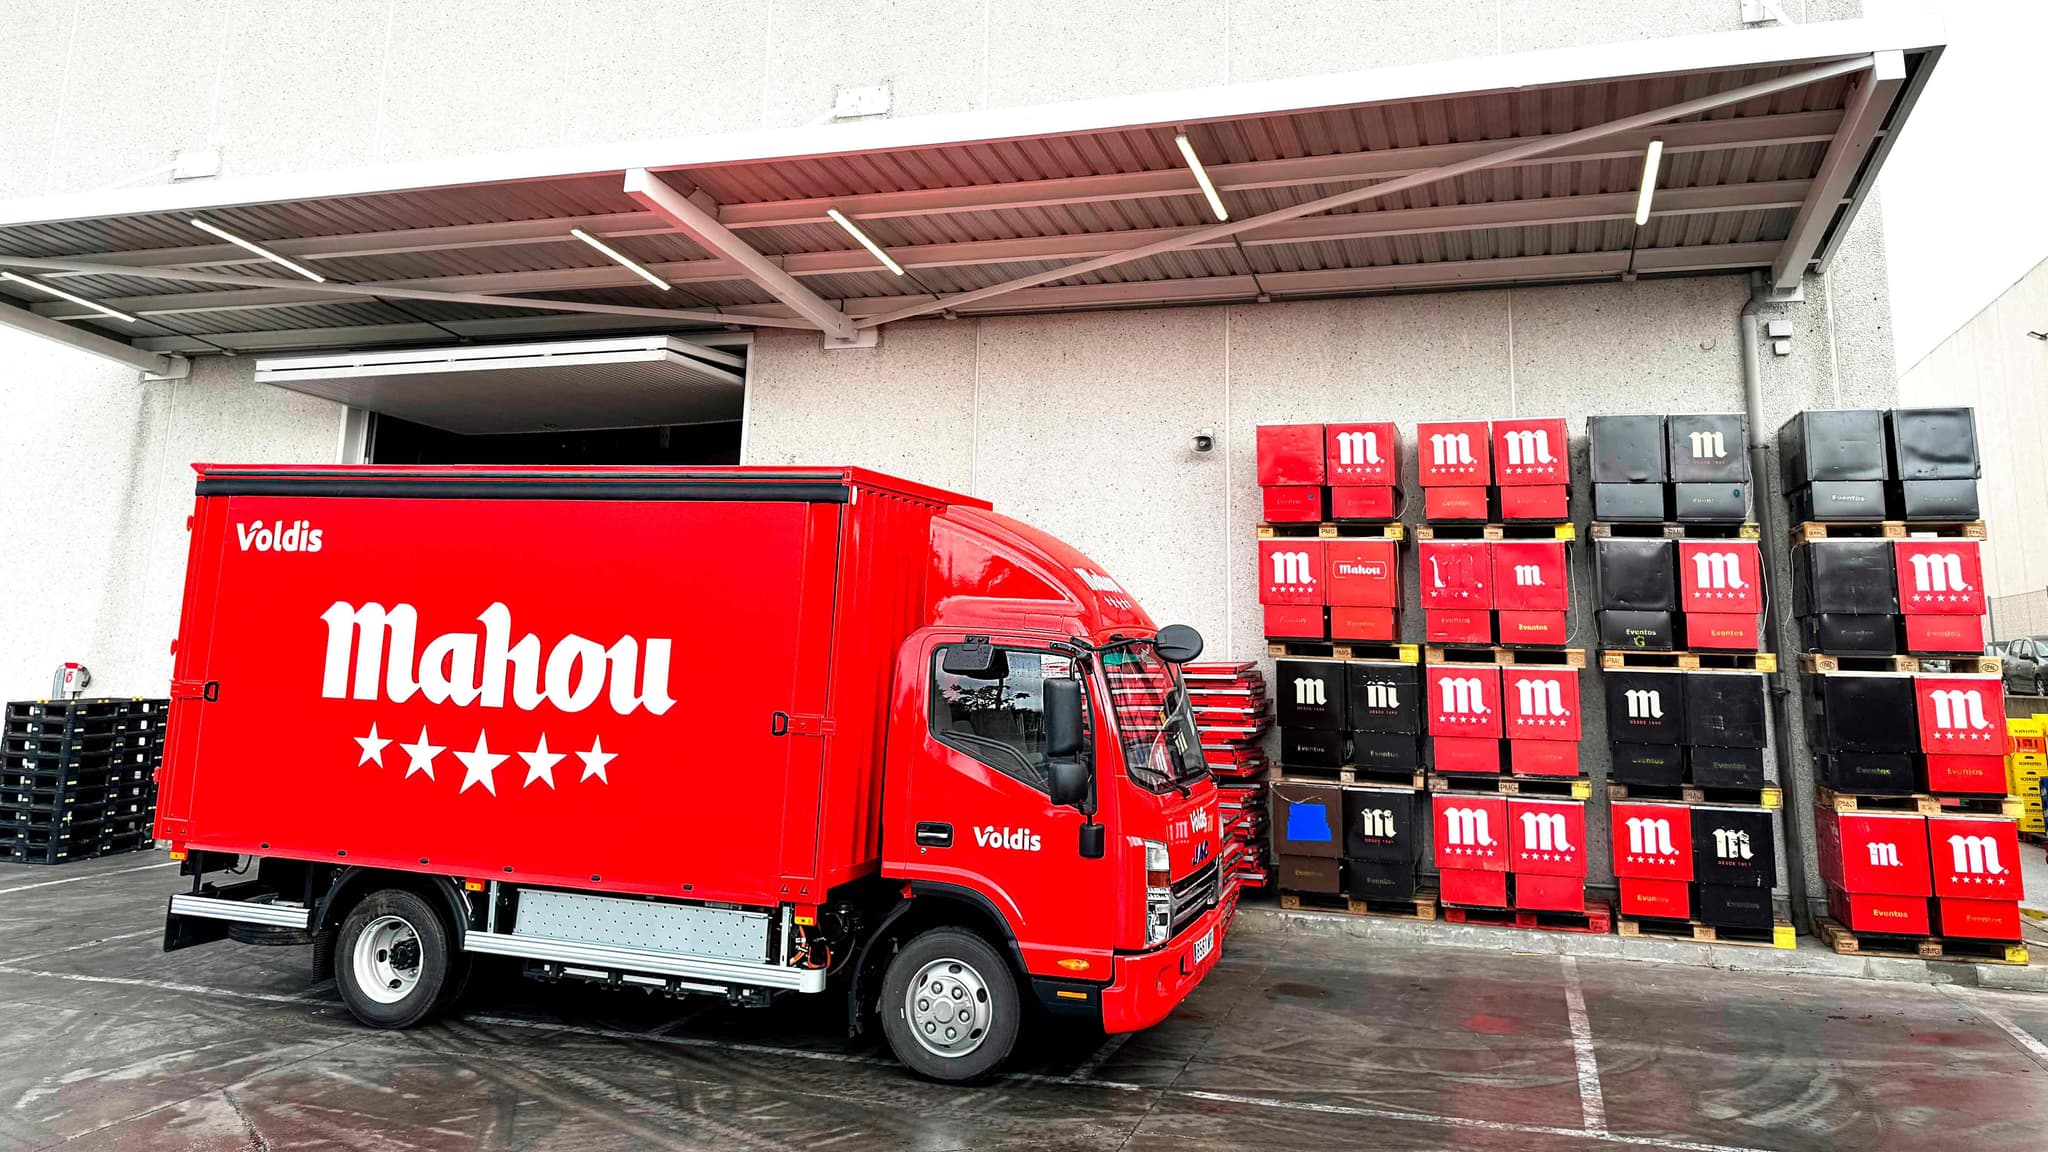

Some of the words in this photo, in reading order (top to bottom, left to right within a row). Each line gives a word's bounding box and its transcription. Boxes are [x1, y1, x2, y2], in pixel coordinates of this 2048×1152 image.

[236, 520, 323, 552] Voldis
[1339, 564, 1380, 575] Mahou
[320, 602, 676, 715] Mahou
[973, 826, 1041, 851] Voldis
[1873, 909, 1909, 918] Eventos
